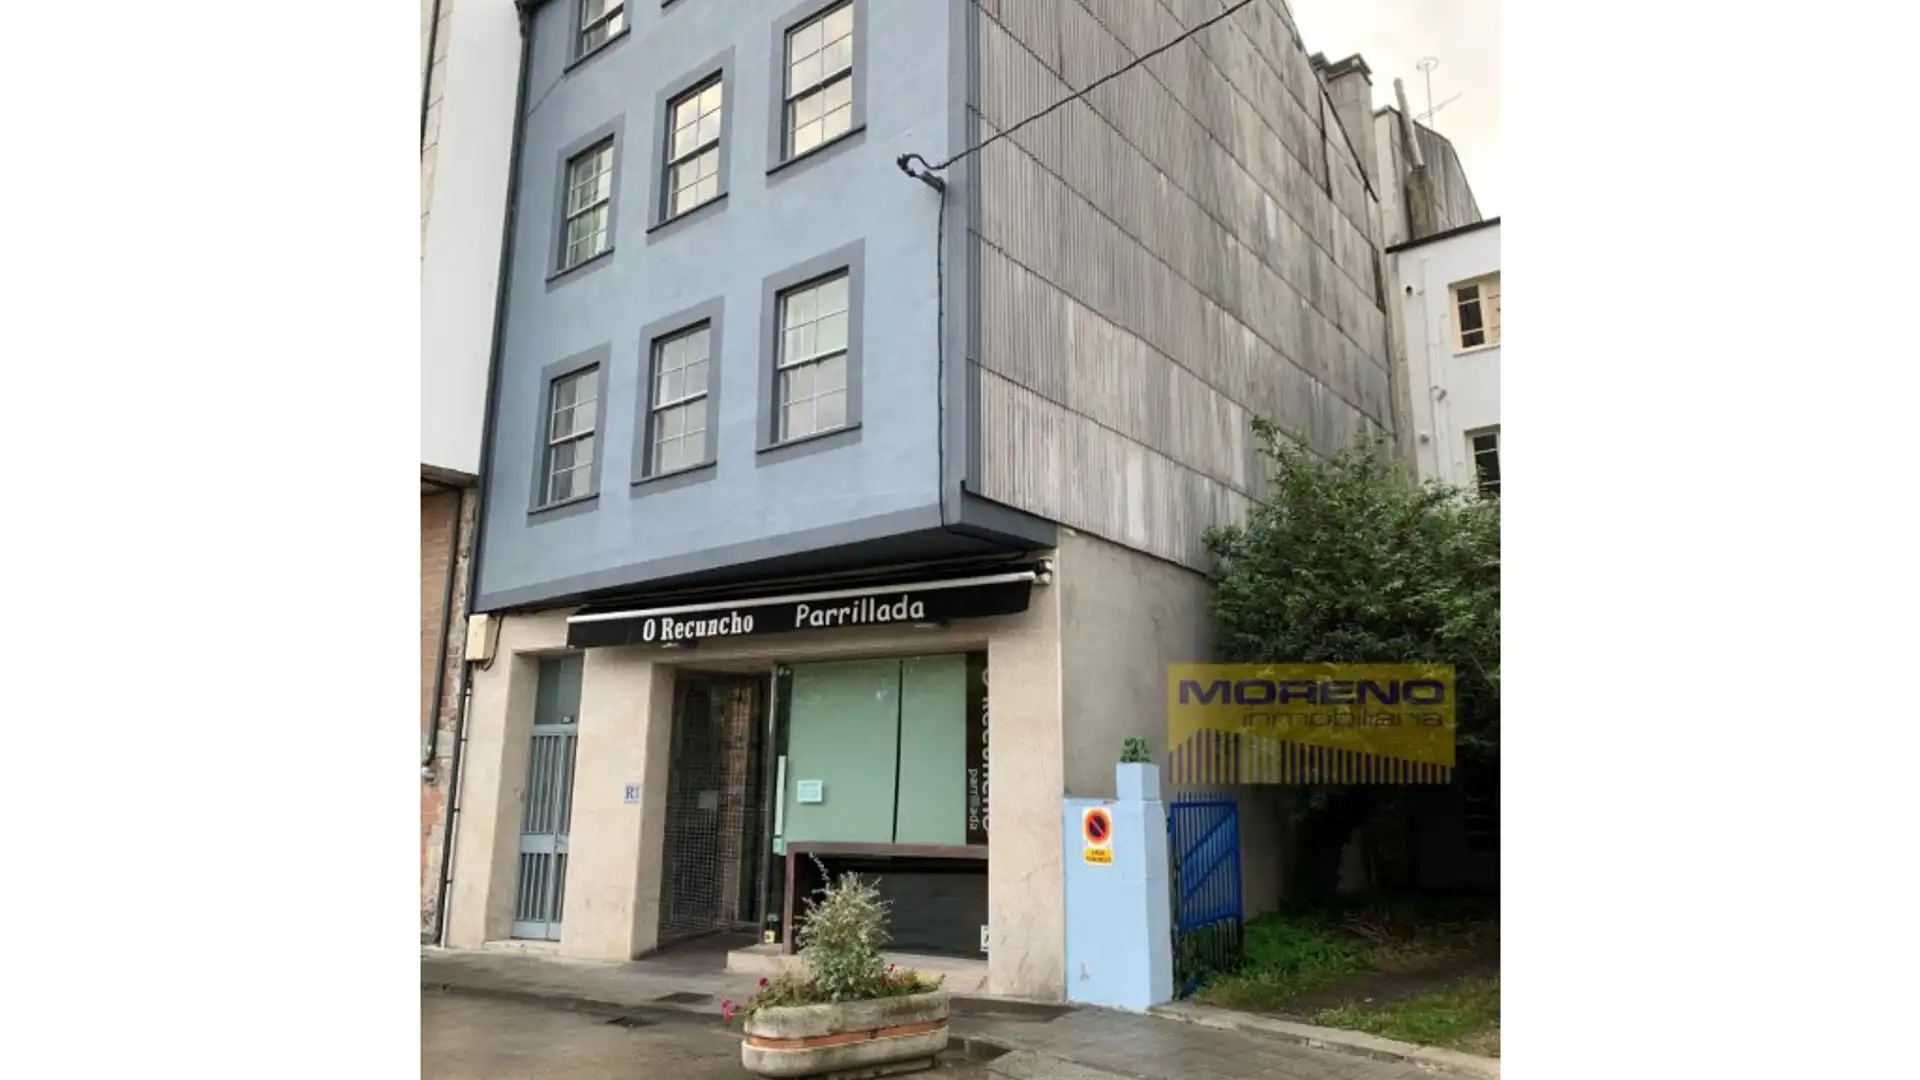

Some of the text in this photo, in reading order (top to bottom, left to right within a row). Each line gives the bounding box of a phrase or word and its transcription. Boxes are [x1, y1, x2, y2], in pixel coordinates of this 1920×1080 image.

[643, 611, 754, 641] O Recuncho
[795, 594, 925, 628] Parrillada
[967, 768, 980, 831] parrada
